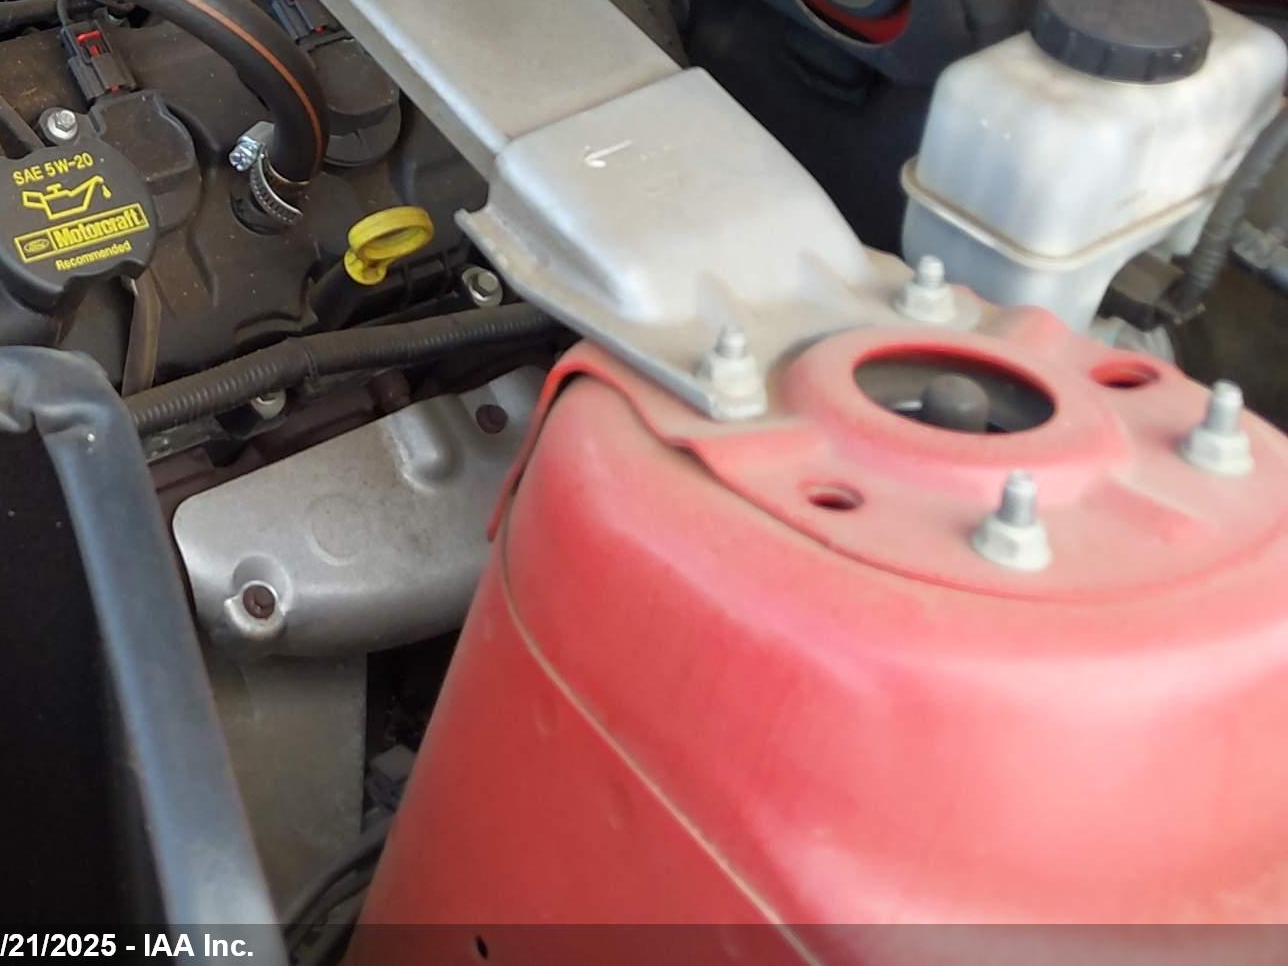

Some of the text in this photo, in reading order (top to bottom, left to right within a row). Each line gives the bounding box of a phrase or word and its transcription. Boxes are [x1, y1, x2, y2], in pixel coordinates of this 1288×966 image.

[13, 152, 93, 185] SAE 5W-20
[52, 208, 142, 248] Motorcraft
[55, 240, 132, 270] Recommended
